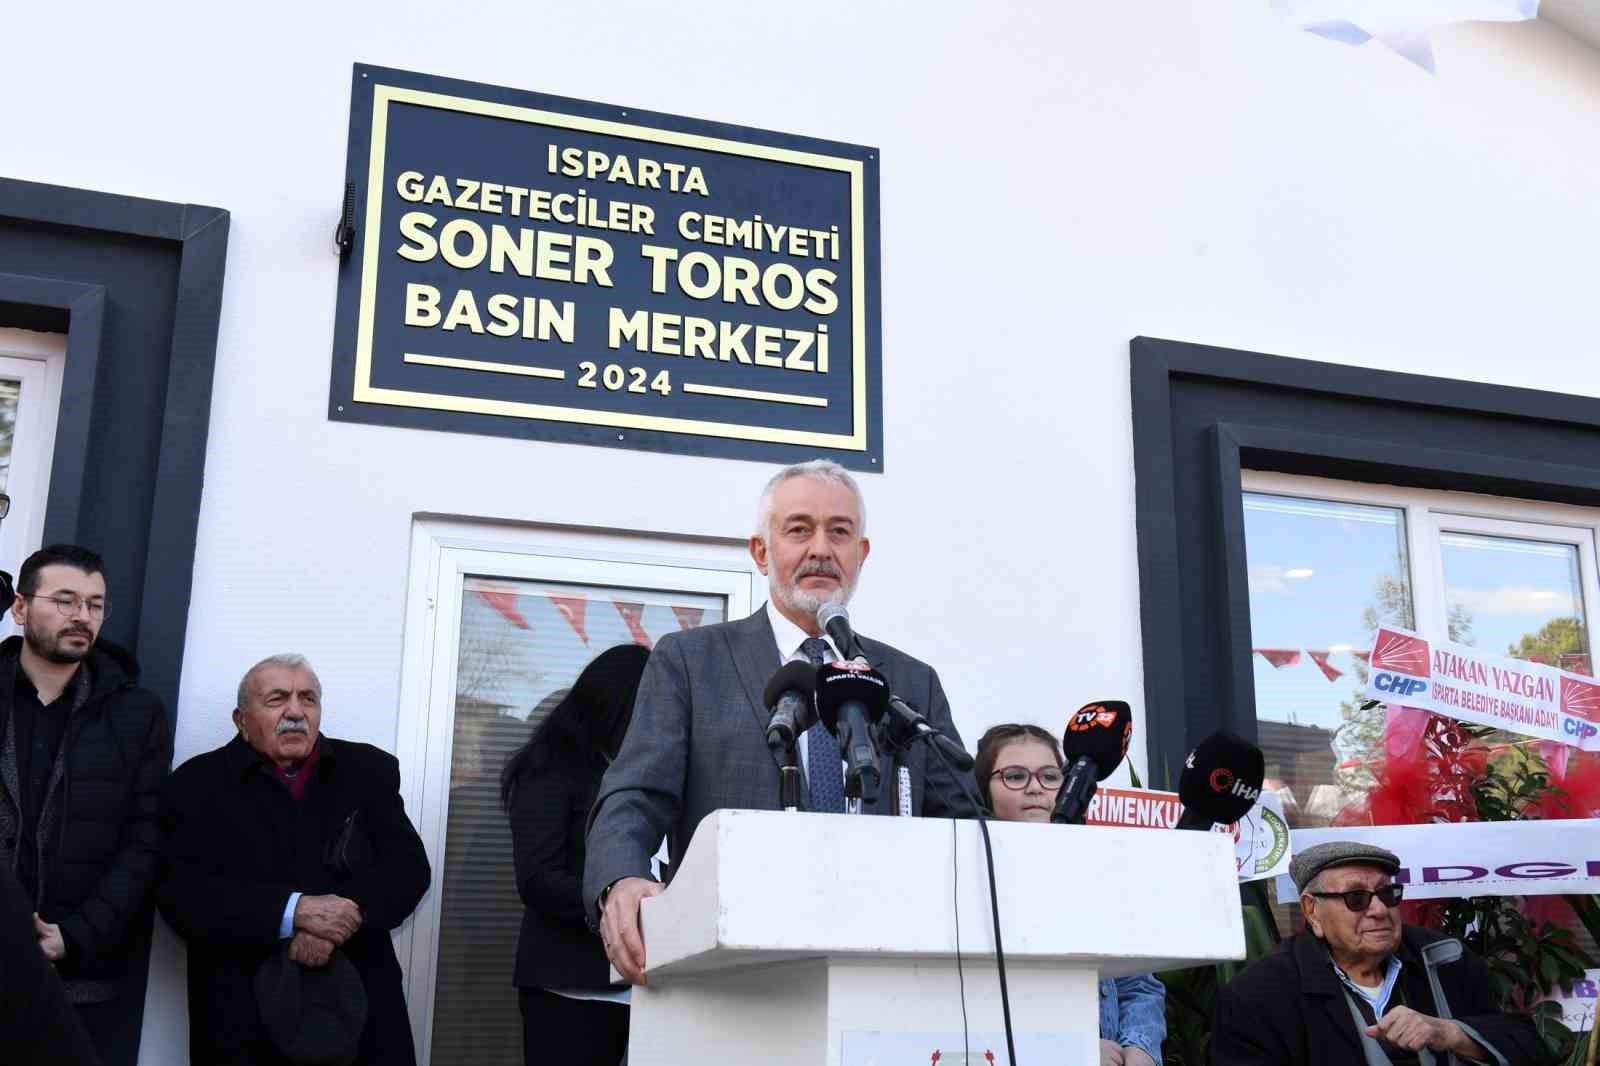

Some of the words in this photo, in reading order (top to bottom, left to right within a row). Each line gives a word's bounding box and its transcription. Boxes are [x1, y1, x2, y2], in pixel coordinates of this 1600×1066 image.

[548, 143, 709, 196] ISPARTA
[396, 170, 655, 235] GAZETECİLER
[678, 211, 840, 260] CEMİYETİ
[396, 211, 614, 287] SONER
[641, 244, 839, 315] TOROS
[404, 282, 575, 343] BASIN
[608, 307, 829, 373] MERKEZİ
[577, 361, 672, 396] 2024
[1375, 672, 1427, 696] CHP
[1432, 650, 1488, 687] ATAKAN
[1491, 666, 1554, 703] YAZGAN
[1431, 680, 1459, 707] ISPARTA
[1460, 690, 1499, 716] BELEDİYE
[1535, 708, 1560, 730] ADAYI
[1564, 717, 1598, 739] CHP
[1087, 788, 1185, 829] RİMENKU
